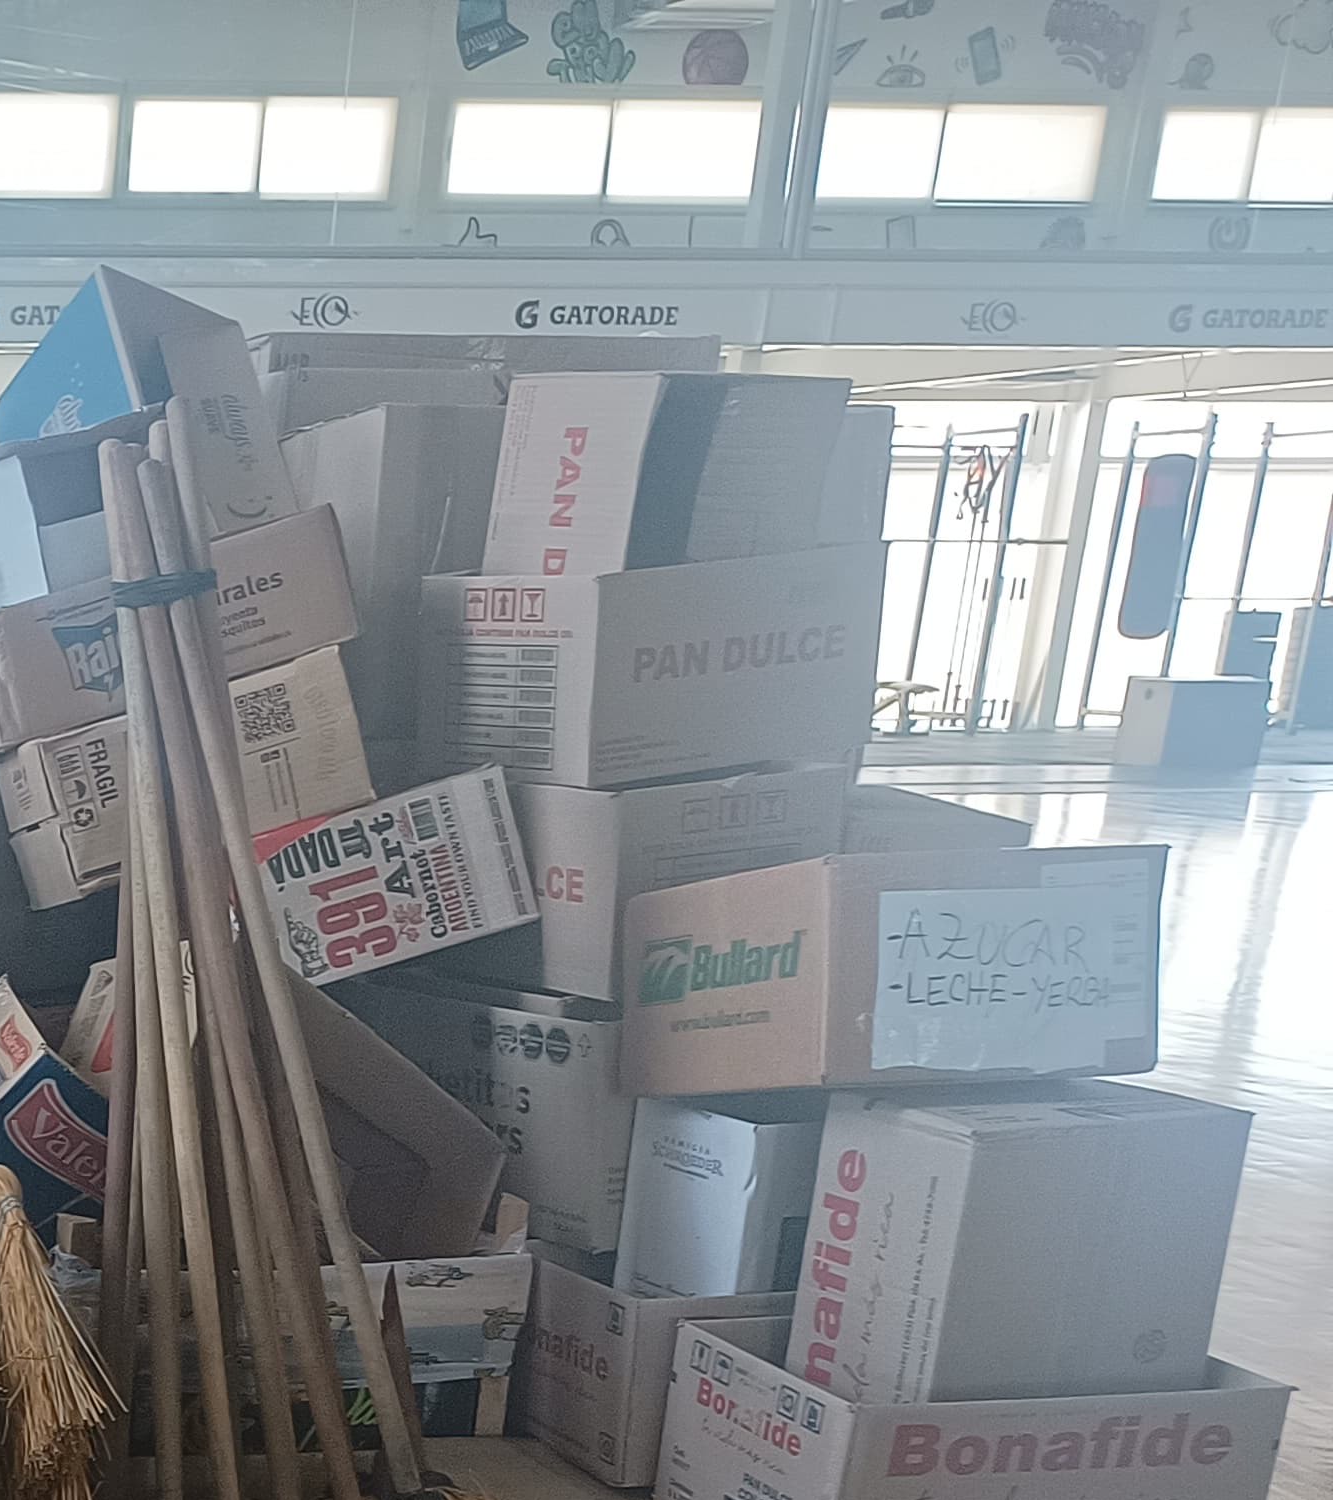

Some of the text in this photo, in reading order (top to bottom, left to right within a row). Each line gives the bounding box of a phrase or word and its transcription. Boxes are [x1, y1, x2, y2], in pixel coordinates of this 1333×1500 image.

[549, 305, 679, 327] GATORADE
[1201, 307, 1329, 330] GATORADE
[555, 426, 589, 527] PAN
[216, 571, 283, 605] irales
[65, 627, 119, 690] Rai
[634, 625, 846, 683] PAN DULCE
[84, 736, 121, 810] FRAGIL
[368, 811, 417, 896] Art
[537, 866, 586, 903] CE
[306, 865, 398, 970] 391
[689, 931, 803, 992] Bullard
[804, 1147, 869, 1388] nafide
[537, 1328, 610, 1383] nafide
[886, 1412, 1233, 1478] Bonafide
